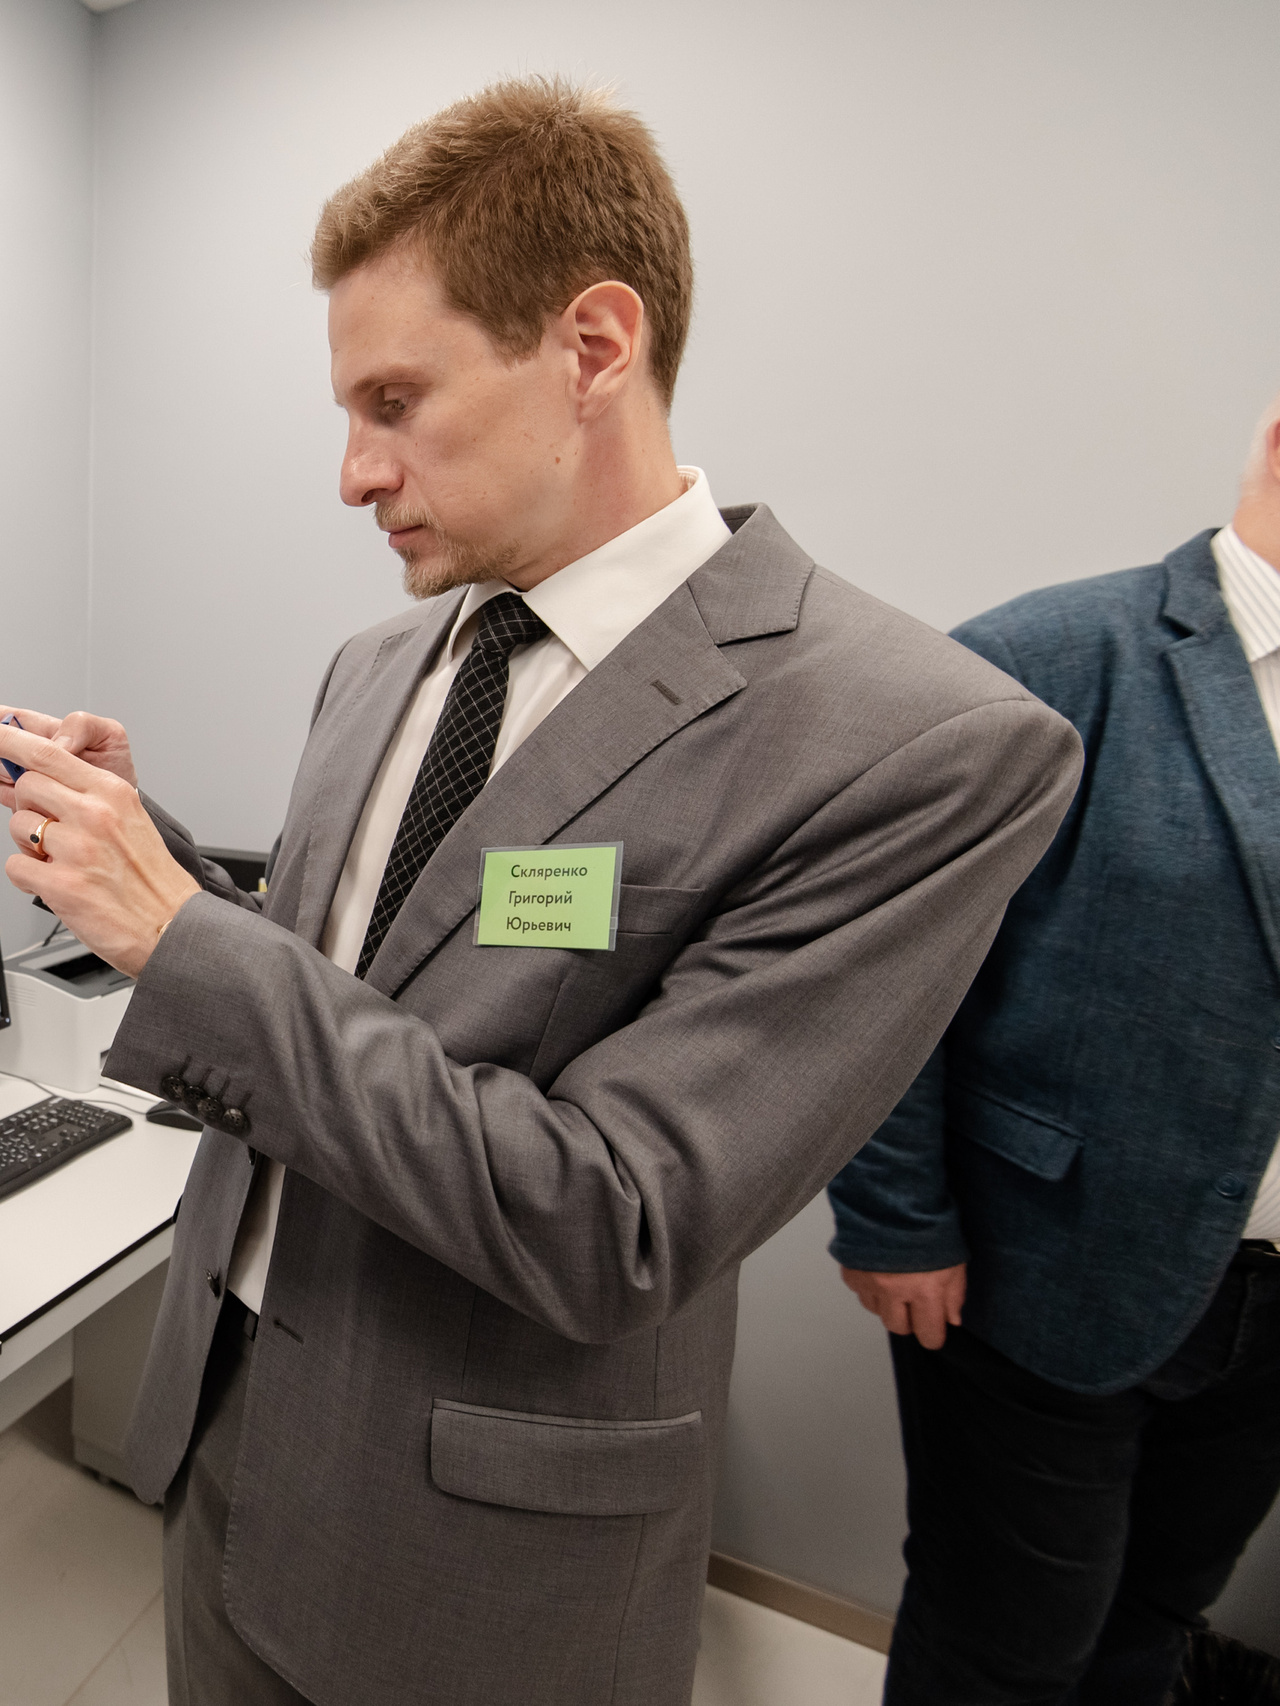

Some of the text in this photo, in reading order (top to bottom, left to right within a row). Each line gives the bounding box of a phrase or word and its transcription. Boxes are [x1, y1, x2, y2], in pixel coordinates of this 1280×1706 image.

[510, 864, 588, 880] Скляренко
[508, 890, 573, 907] Григорий
[506, 916, 572, 933] Юрьевич
